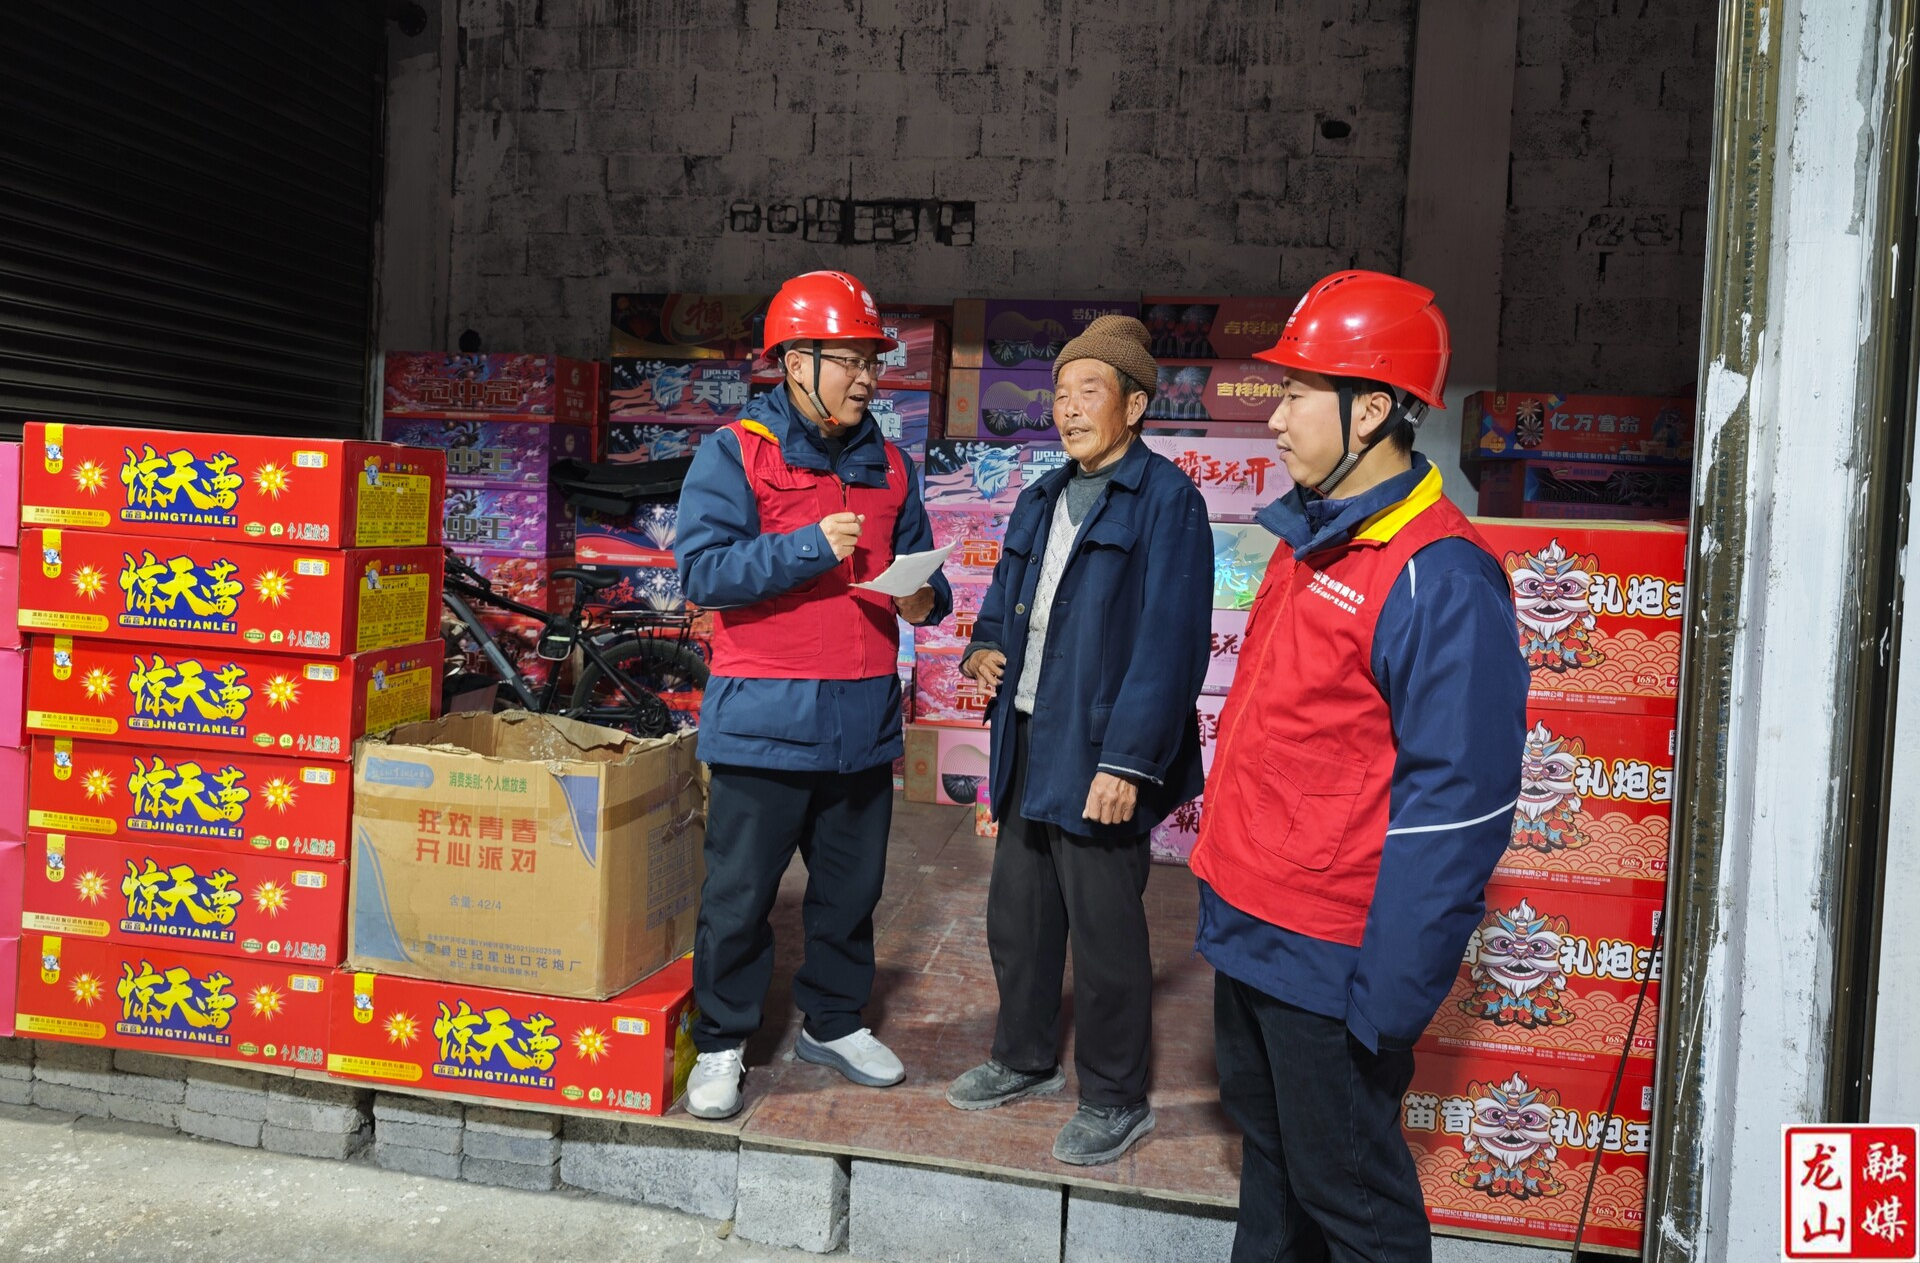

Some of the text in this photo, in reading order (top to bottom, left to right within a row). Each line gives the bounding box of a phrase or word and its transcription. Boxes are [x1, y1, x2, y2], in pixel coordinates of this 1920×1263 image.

[702, 368, 741, 380] WOLVES
[692, 381, 748, 405] 天狼
[869, 399, 894, 411] LVES
[1549, 411, 1641, 434] 亿万富翁
[448, 447, 514, 475] 中王
[1173, 449, 1276, 496] 霸王花开
[145, 511, 236, 525] JINGTIANLEI
[445, 514, 513, 542] 中王
[144, 617, 235, 632] JINGTIANLEI
[153, 721, 244, 736] JINGTIANLEI
[151, 822, 242, 838] JINGTIANLEI
[418, 808, 538, 844] 狂欢青春
[416, 838, 537, 873] 开心派对
[143, 925, 234, 942] JINGTIANLEI
[139, 1028, 230, 1046] JINGTIANLEI
[459, 1068, 554, 1088] JINGTIANLEI
[1404, 1093, 1476, 1135] 笛音
